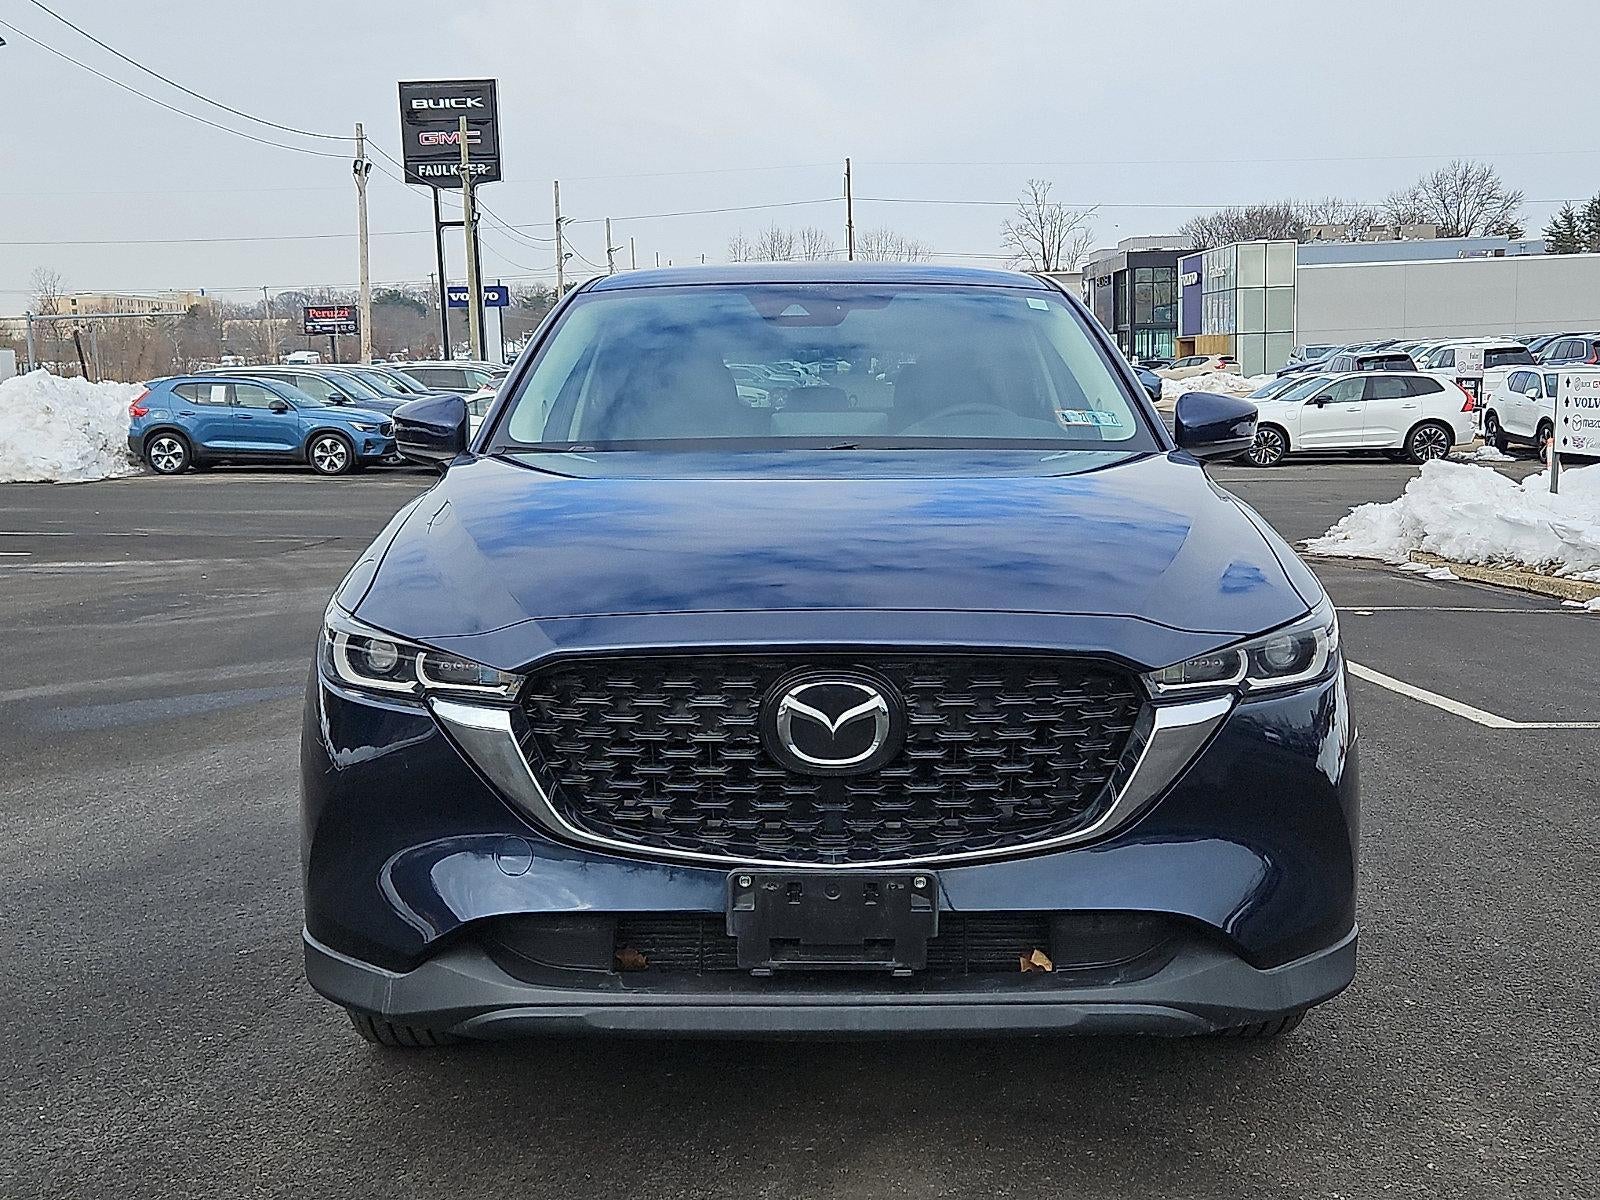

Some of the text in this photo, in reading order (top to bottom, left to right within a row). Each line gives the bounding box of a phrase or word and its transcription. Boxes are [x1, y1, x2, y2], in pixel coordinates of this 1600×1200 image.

[411, 97, 484, 109] BUICK
[418, 163, 488, 176] FAULKER
[448, 291, 499, 302] VOO
